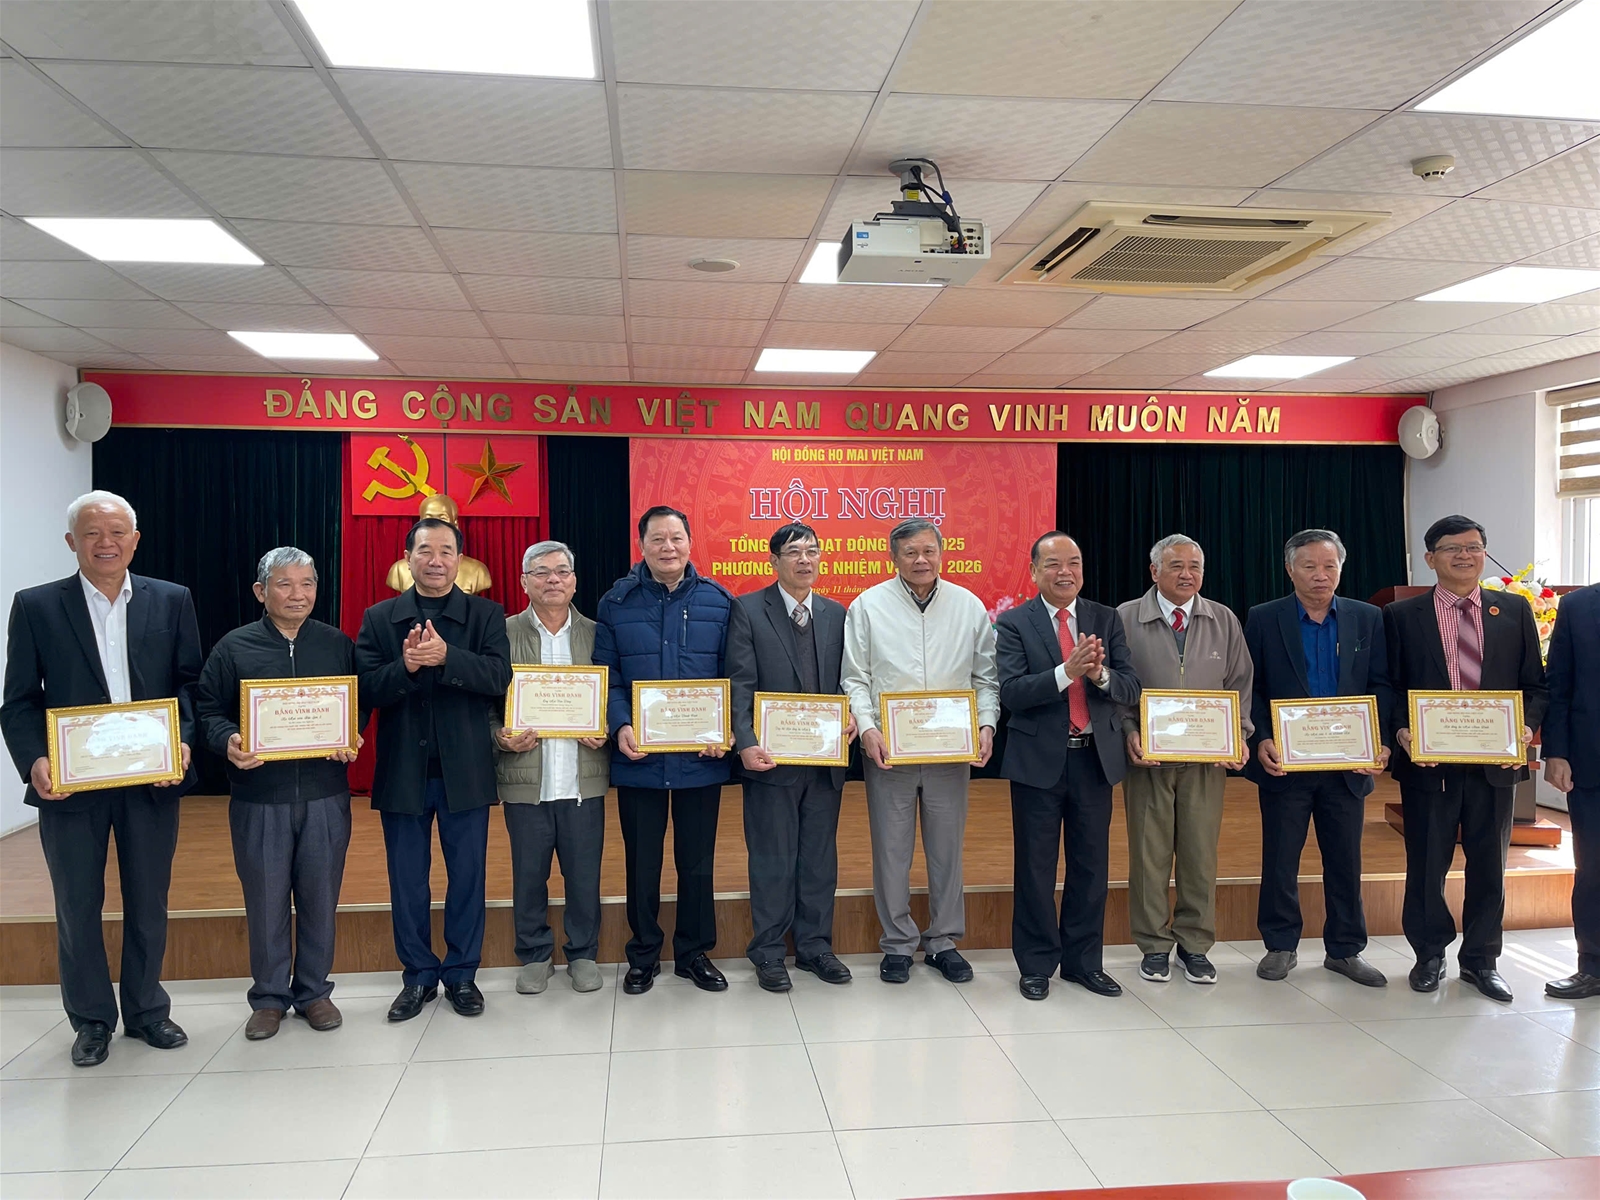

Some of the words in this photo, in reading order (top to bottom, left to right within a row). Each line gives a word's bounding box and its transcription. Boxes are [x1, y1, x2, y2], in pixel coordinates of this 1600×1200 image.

[263, 378, 378, 420] ĐẢNG
[402, 384, 512, 428] CỘNG
[533, 384, 612, 425] SẢN
[637, 391, 720, 434] VIỆT
[743, 400, 821, 430] NAM
[845, 402, 969, 432] QUANG
[988, 404, 1069, 432] VINH
[1090, 396, 1187, 433] MUÔN
[1207, 398, 1281, 433] NĂM
[771, 446, 791, 464] HỘI
[793, 445, 825, 461] ĐỒNG
[828, 448, 843, 464] HỌ
[847, 448, 868, 461] MAI
[871, 446, 895, 464] VIỆT
[897, 448, 924, 461] NAM
[750, 478, 829, 524] HỘI
[837, 487, 946, 526] NGHỊ
[729, 533, 769, 553] TỔNG
[818, 538, 842, 555] OẠT
[846, 535, 887, 554] ĐỘNG
[941, 537, 965, 551] 025
[712, 560, 773, 576] PHƯƠNG
[833, 558, 881, 577] NHIỆM
[886, 561, 899, 574] V
[947, 560, 982, 574] 2026
[832, 585, 842, 593] 11
